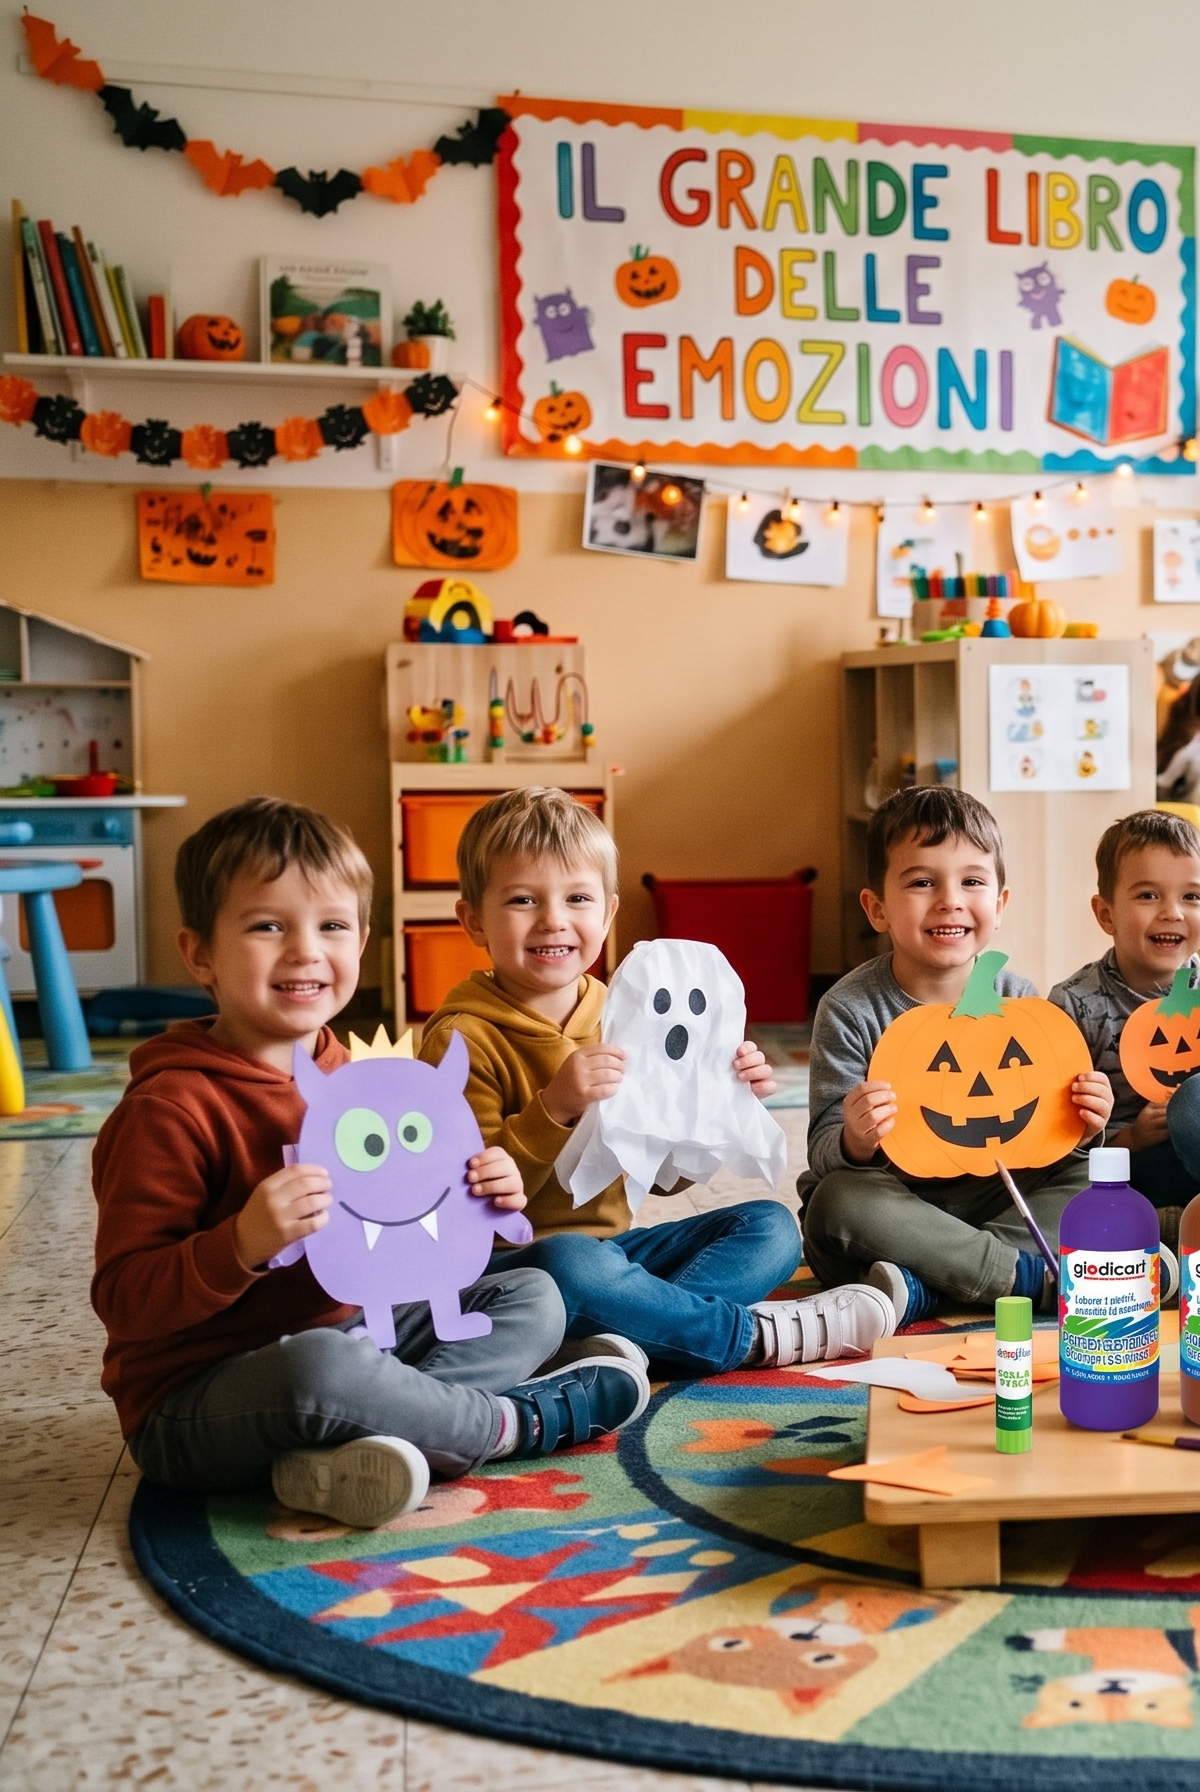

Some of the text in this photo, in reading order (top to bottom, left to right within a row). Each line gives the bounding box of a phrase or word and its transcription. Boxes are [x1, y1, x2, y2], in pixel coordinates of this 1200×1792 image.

[556, 141, 1168, 254] IL GRANDE LIBRO
[733, 244, 942, 325] DELLE
[621, 332, 1014, 432] EMOZIONI
[1074, 1259, 1146, 1278] giodicart
